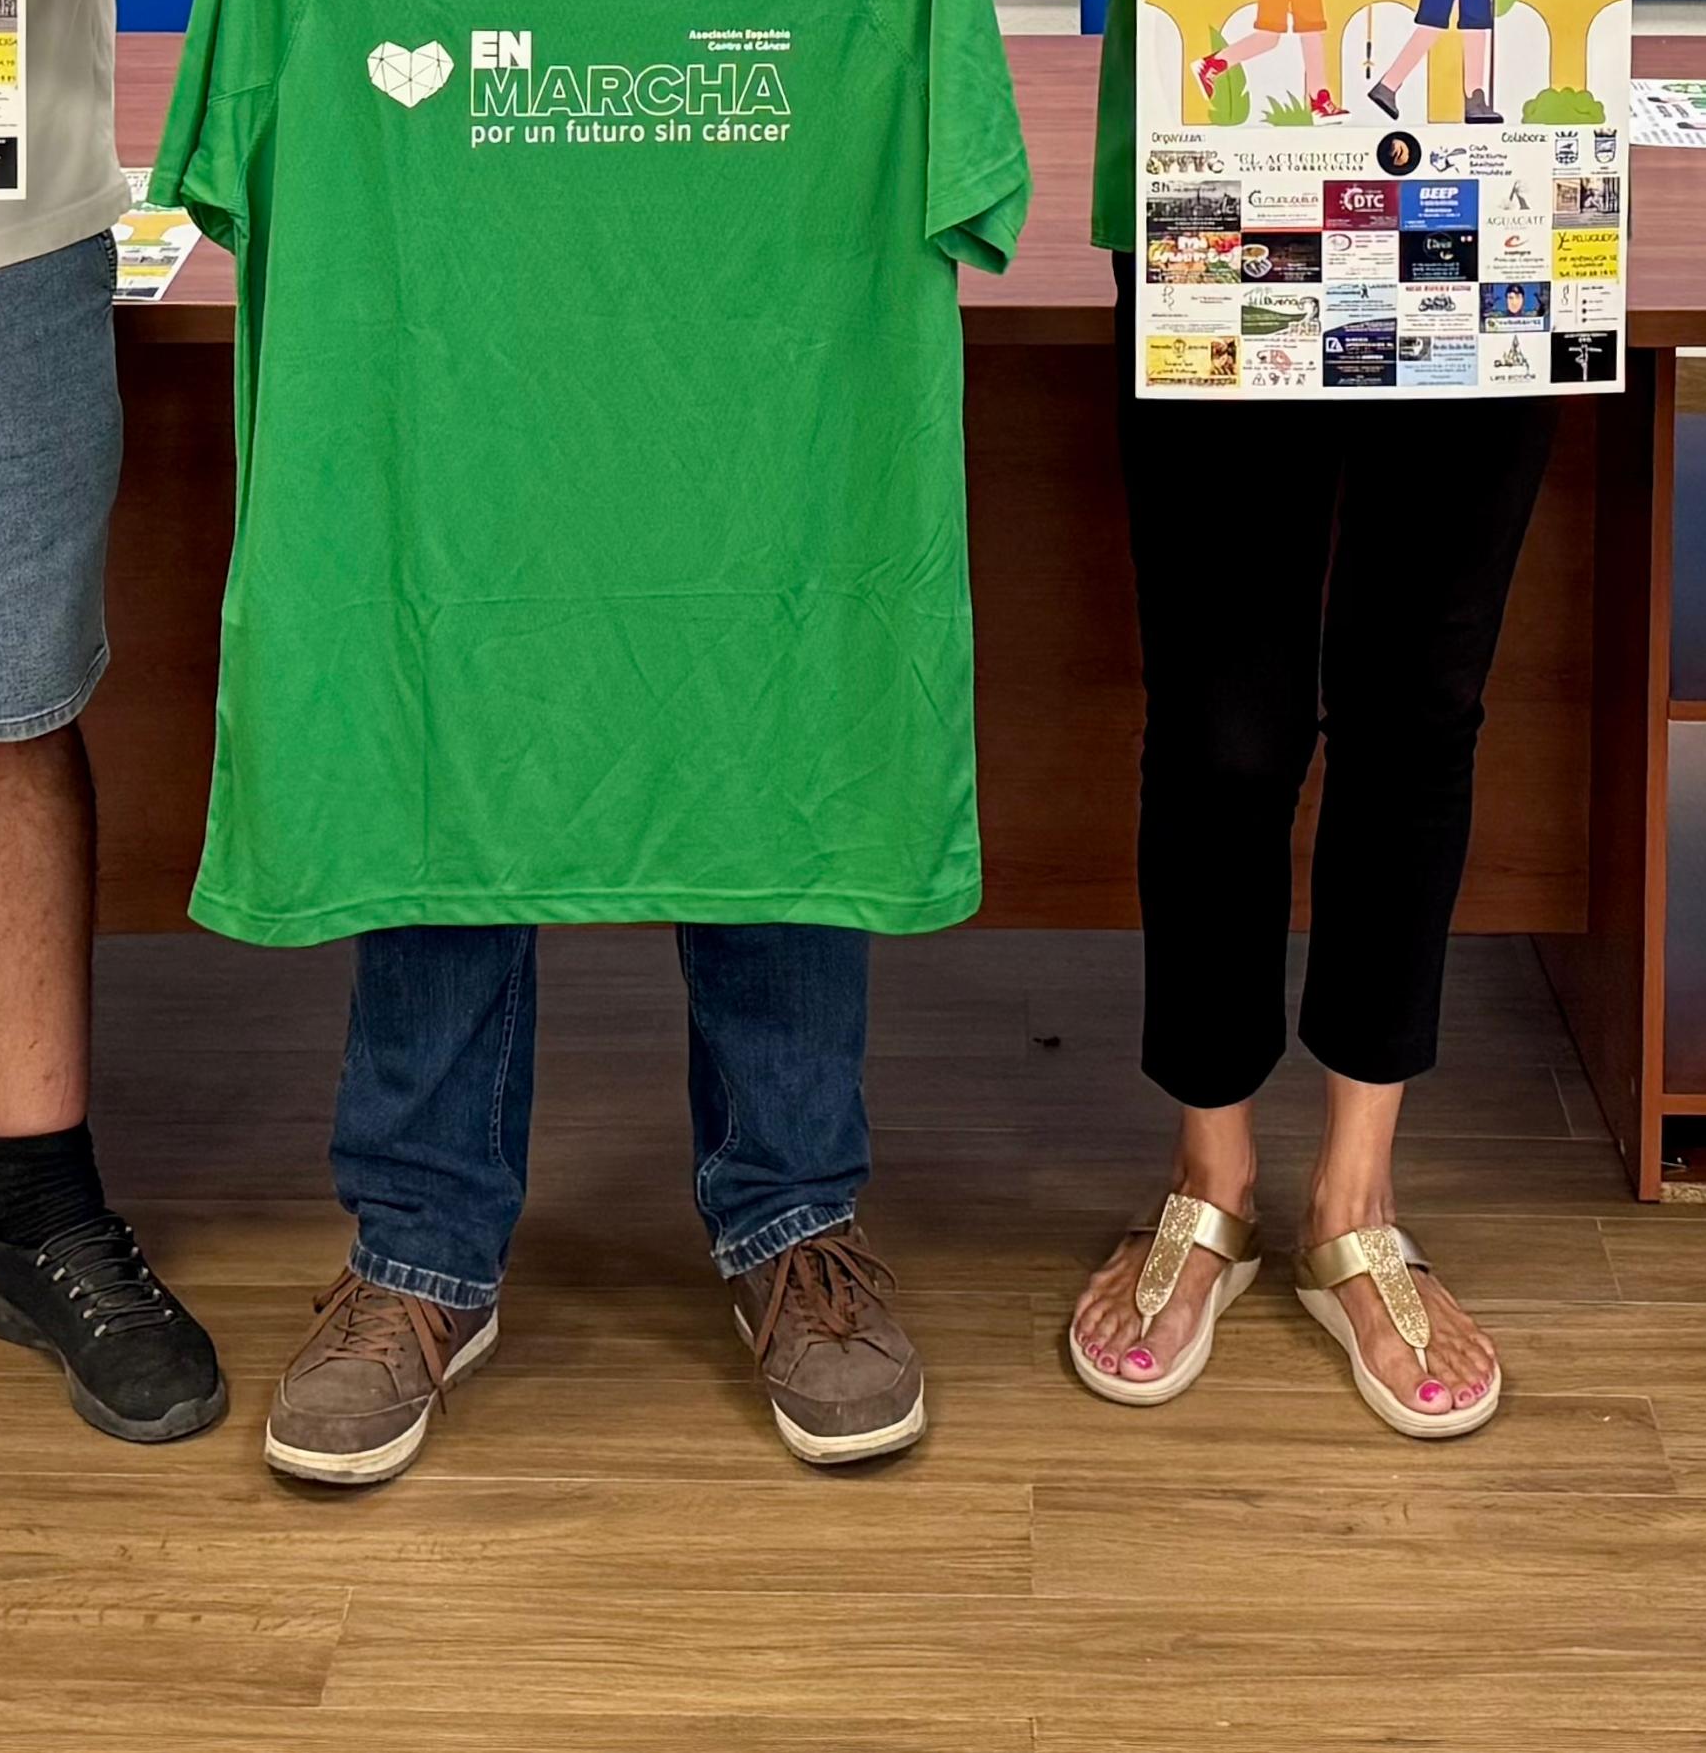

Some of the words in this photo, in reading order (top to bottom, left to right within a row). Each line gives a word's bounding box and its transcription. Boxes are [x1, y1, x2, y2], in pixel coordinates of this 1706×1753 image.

[471, 31, 532, 68] EN
[470, 63, 790, 117] MARCHA
[472, 123, 514, 148] por
[526, 124, 555, 142] un
[567, 120, 645, 142] futuro
[655, 120, 691, 141] sin
[702, 118, 790, 142] cáncer
[1502, 132, 1547, 143] Colabora:
[1355, 194, 1384, 207] DTC
[1420, 188, 1458, 199] BEEP
